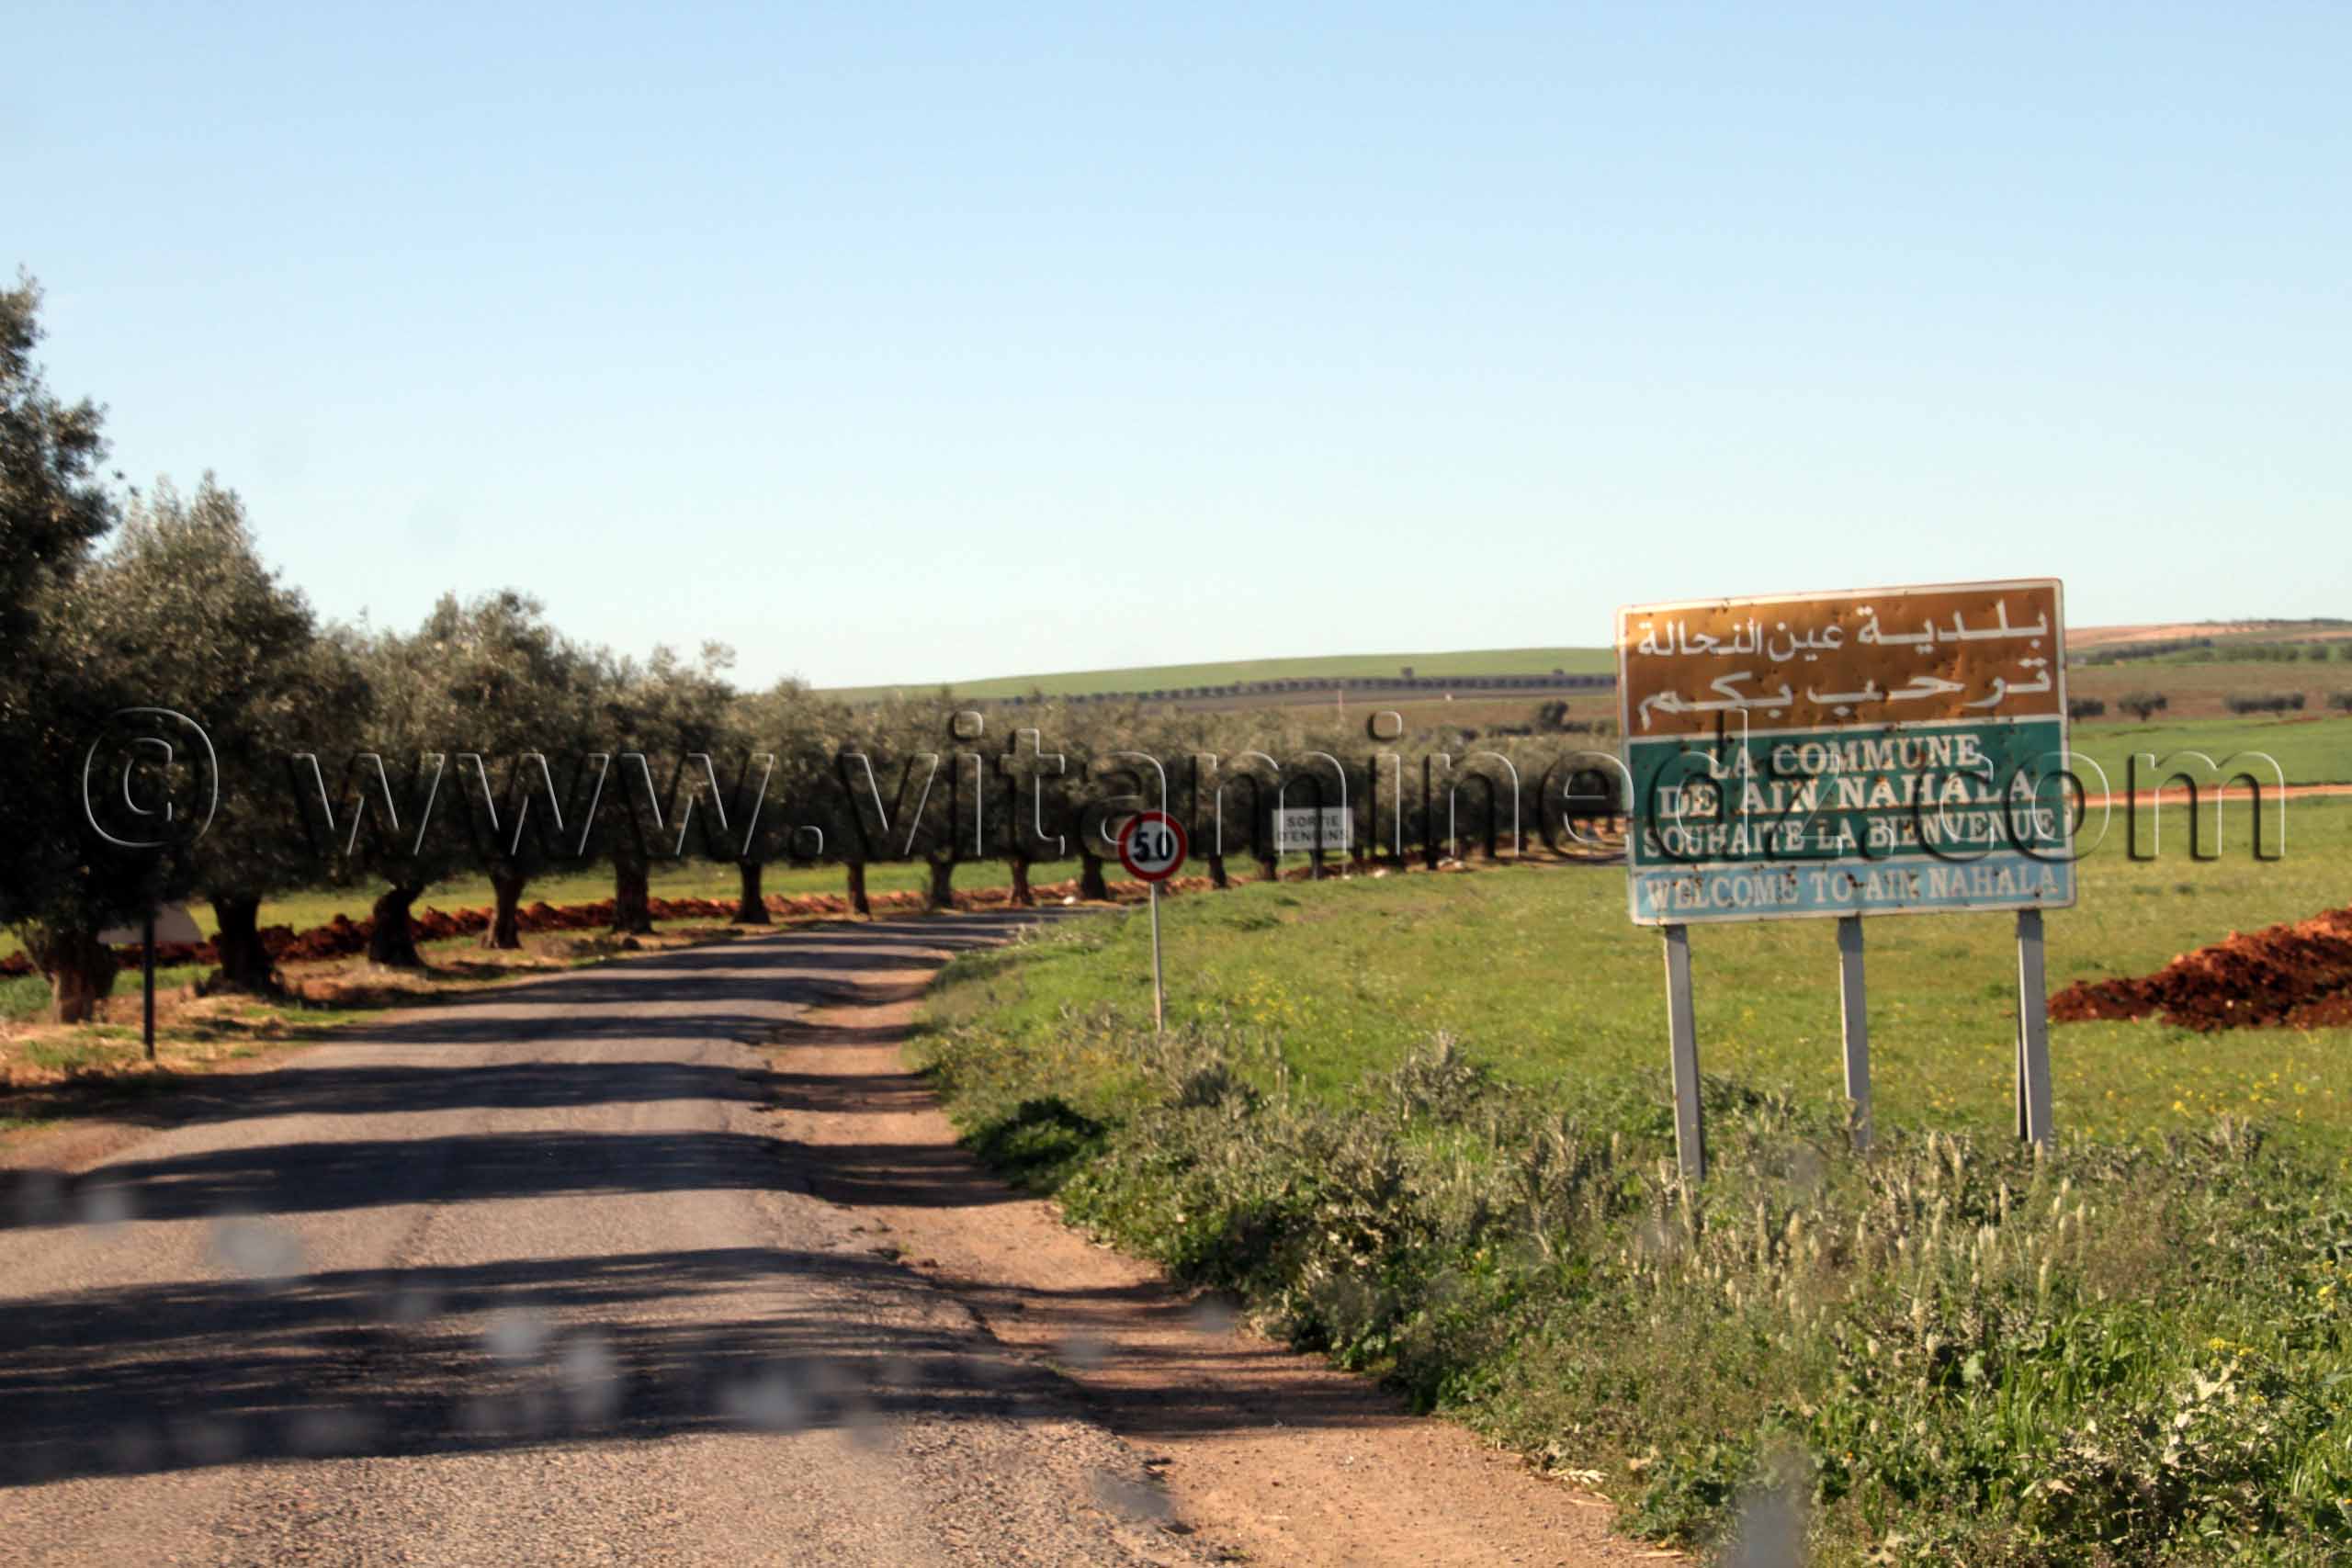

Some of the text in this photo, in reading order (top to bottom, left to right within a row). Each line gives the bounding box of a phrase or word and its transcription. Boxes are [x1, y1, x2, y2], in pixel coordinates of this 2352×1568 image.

[1638, 598, 2048, 662] بلدية عين النحالة
[1638, 657, 2052, 730] ترحب بكم
[1707, 733, 1984, 780] LA COMMUNE
[1657, 768, 2037, 819] DE AIN NAHALA
[1132, 830, 1173, 863] 50
[1642, 807, 2056, 858] SOUHAITE LA BIENVENUE
[1645, 863, 2059, 912] WELCOME TO AIN NAHALA
